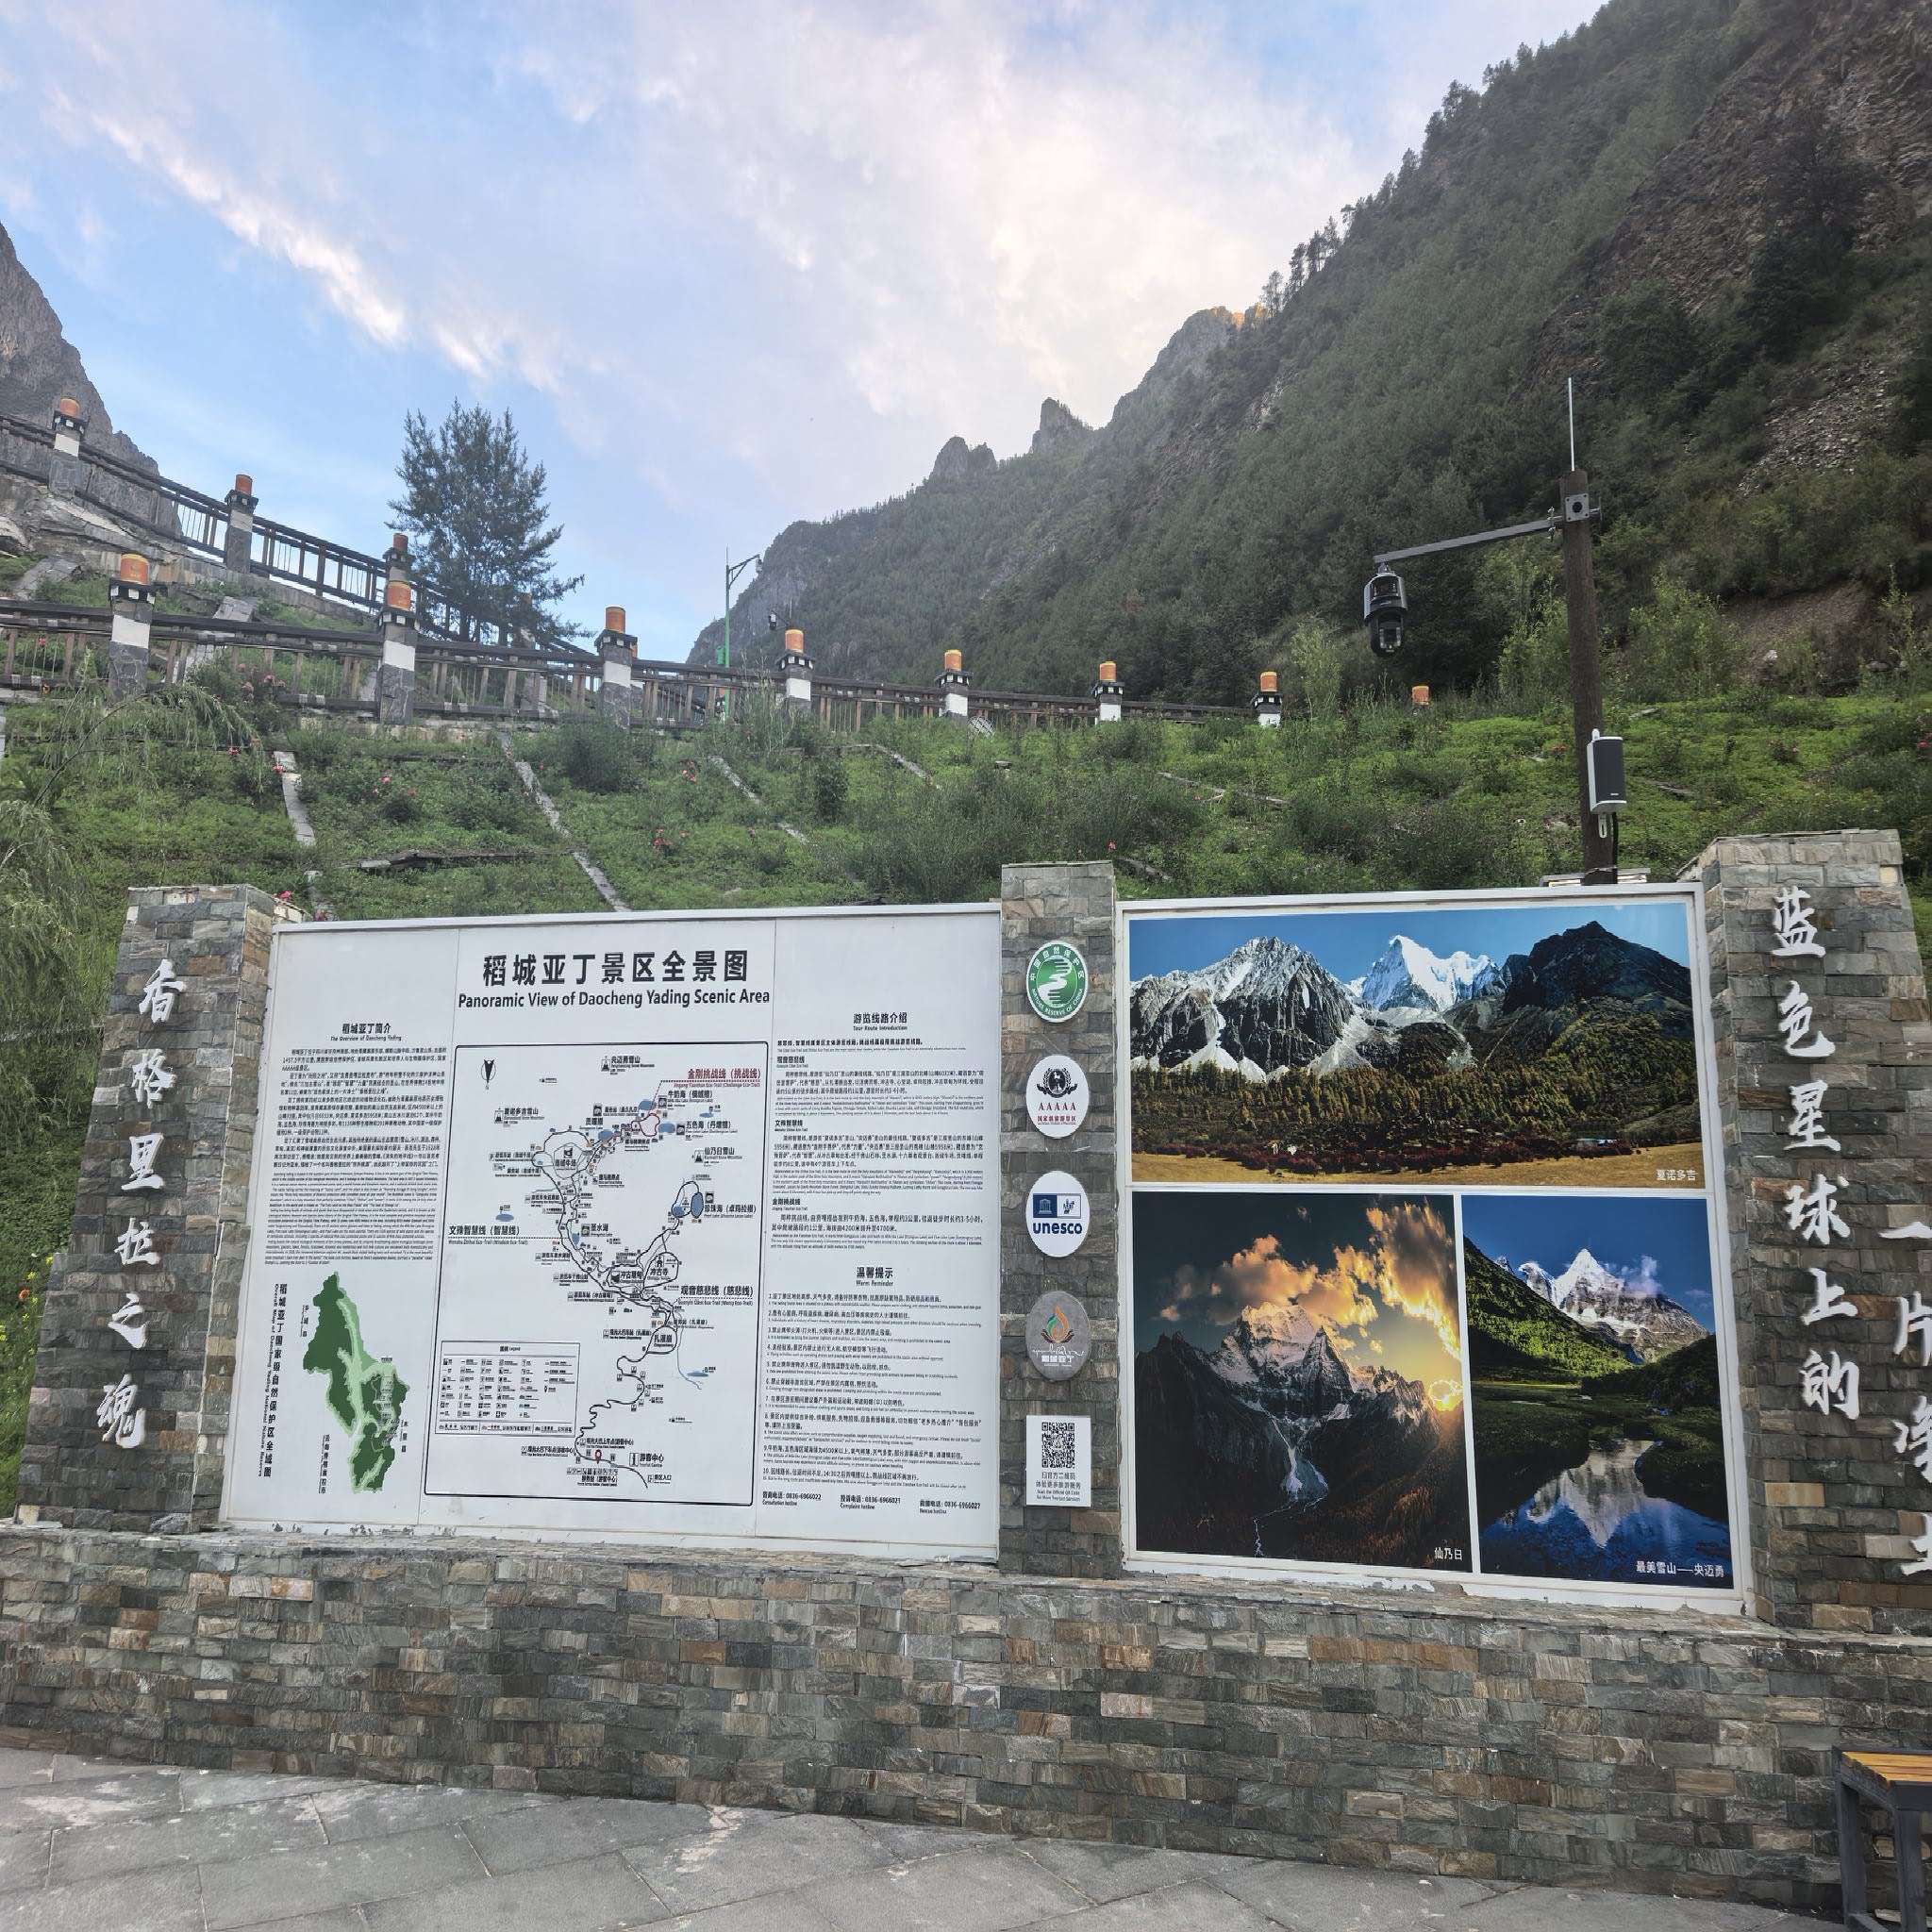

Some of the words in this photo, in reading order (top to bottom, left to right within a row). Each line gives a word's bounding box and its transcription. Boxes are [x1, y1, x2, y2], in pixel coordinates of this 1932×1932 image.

[483, 950, 747, 987] 稻城亚丁景区全景图
[458, 992, 525, 1008] Panoramic
[528, 992, 558, 1007] View
[562, 991, 575, 1006] of
[578, 991, 642, 1008] Daocheng
[646, 990, 691, 1008] Yading
[694, 989, 736, 1005] Scenic
[739, 990, 770, 1004] Area
[854, 1012, 908, 1024] 游览线路介绍
[342, 1023, 391, 1034] 稻城亚丁简介
[688, 1068, 760, 1079] 金刚挑战线(挑战线)
[1772, 886, 1860, 1421] 蓝色星球上的
[96, 958, 186, 1450] 香格里拉之魂
[448, 1225, 521, 1237] 文殊智慧线(智慧线)
[1032, 1222, 1083, 1235] unesco
[857, 1266, 893, 1278] 温馨提示
[639, 1453, 664, 1462] 游客中心
[1434, 1547, 1463, 1561] 仙乃日
[1636, 1560, 1725, 1578] 最美雪山——央迈勇
